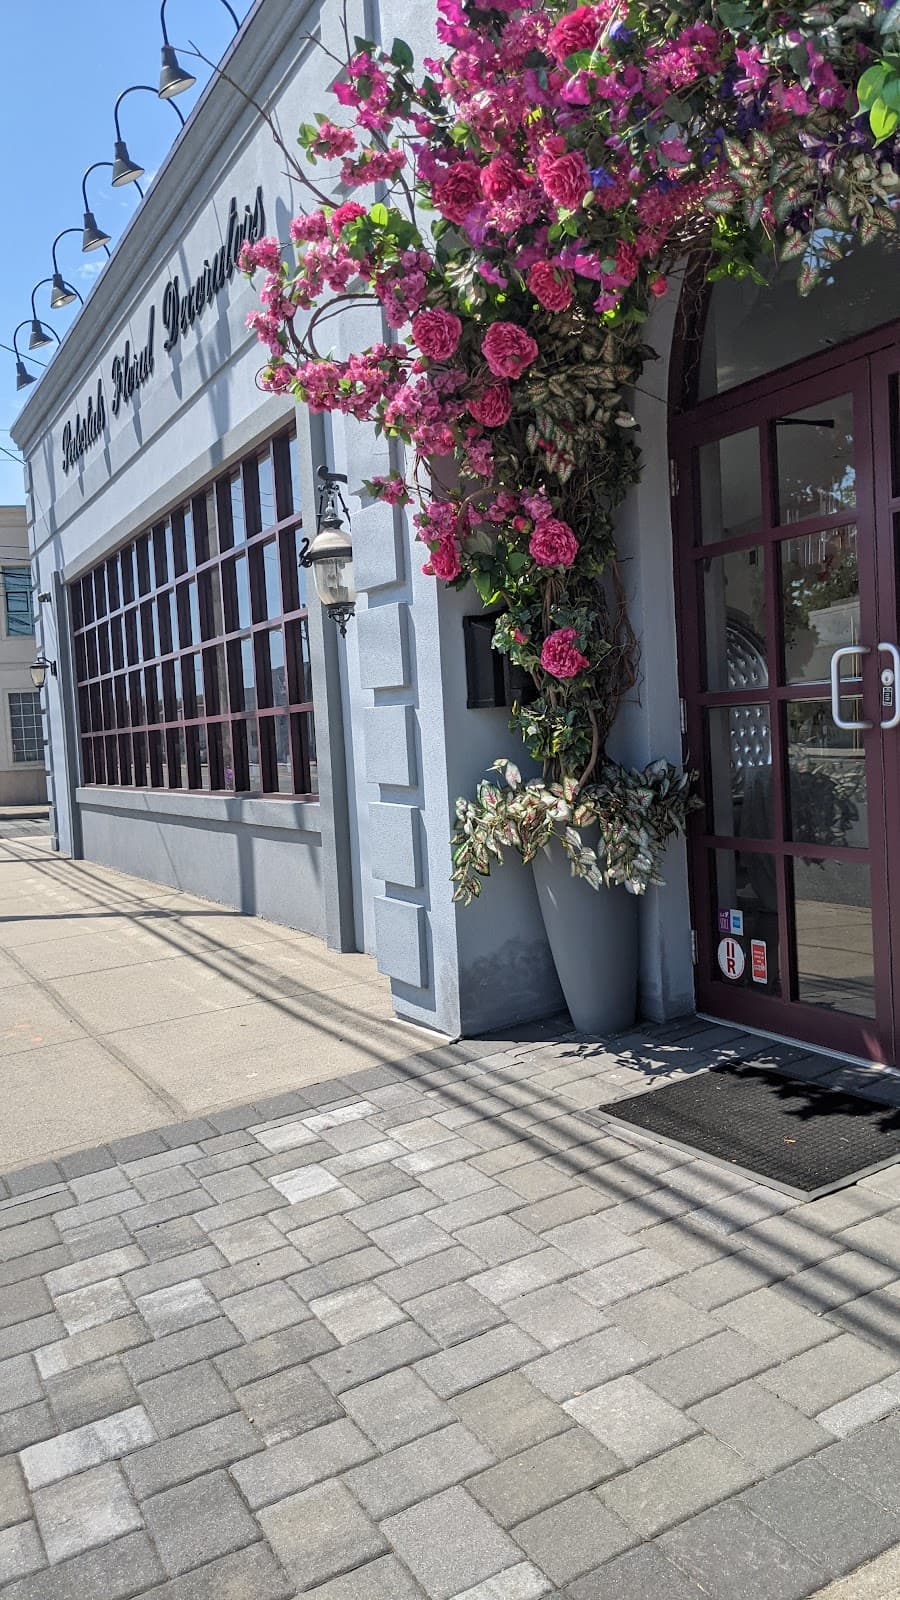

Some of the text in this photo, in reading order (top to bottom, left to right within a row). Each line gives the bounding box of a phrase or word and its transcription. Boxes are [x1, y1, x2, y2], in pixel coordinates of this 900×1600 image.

[112, 305, 155, 415] Floral
[163, 185, 266, 353] Decorators
[727, 958, 736, 974] R
